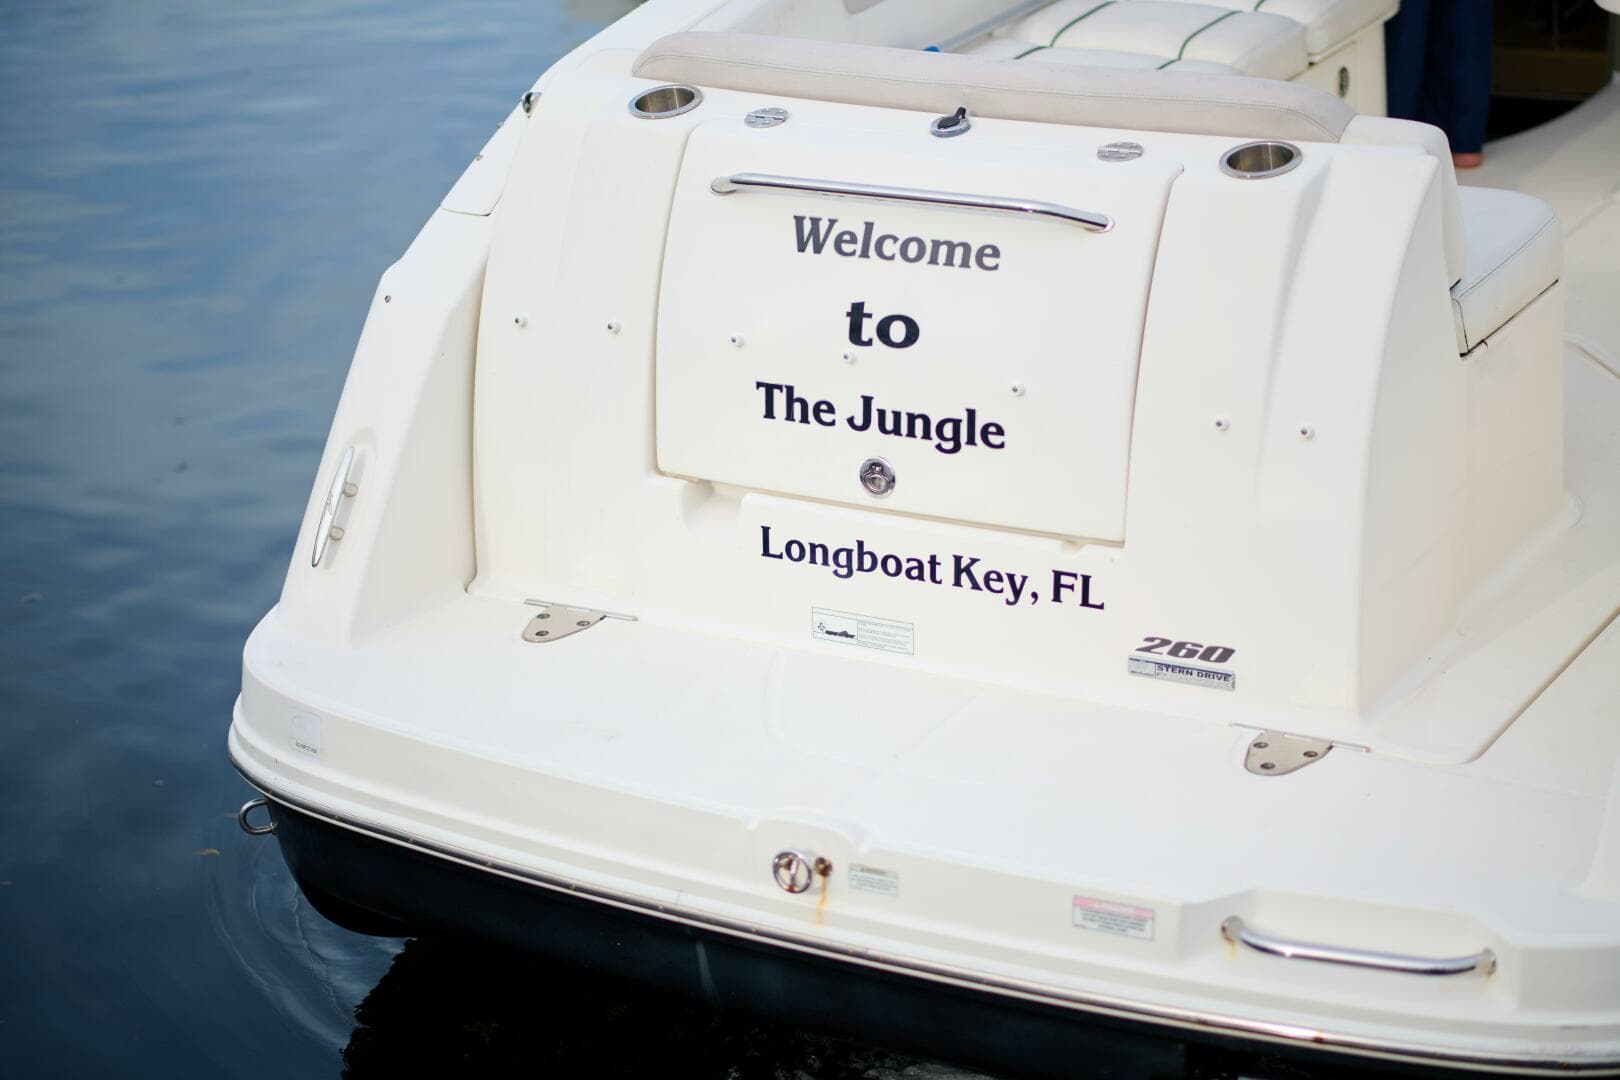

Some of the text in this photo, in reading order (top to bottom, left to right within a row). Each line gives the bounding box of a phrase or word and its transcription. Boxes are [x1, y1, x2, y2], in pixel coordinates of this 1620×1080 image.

[793, 215, 1001, 271] Welcome
[845, 301, 920, 349] to
[755, 380, 1006, 455] The Jungle
[760, 525, 1105, 611] Longboat Key, FL
[1135, 636, 1236, 664] 260
[1156, 665, 1193, 677] STERN
[1196, 671, 1231, 682] DRIVE
